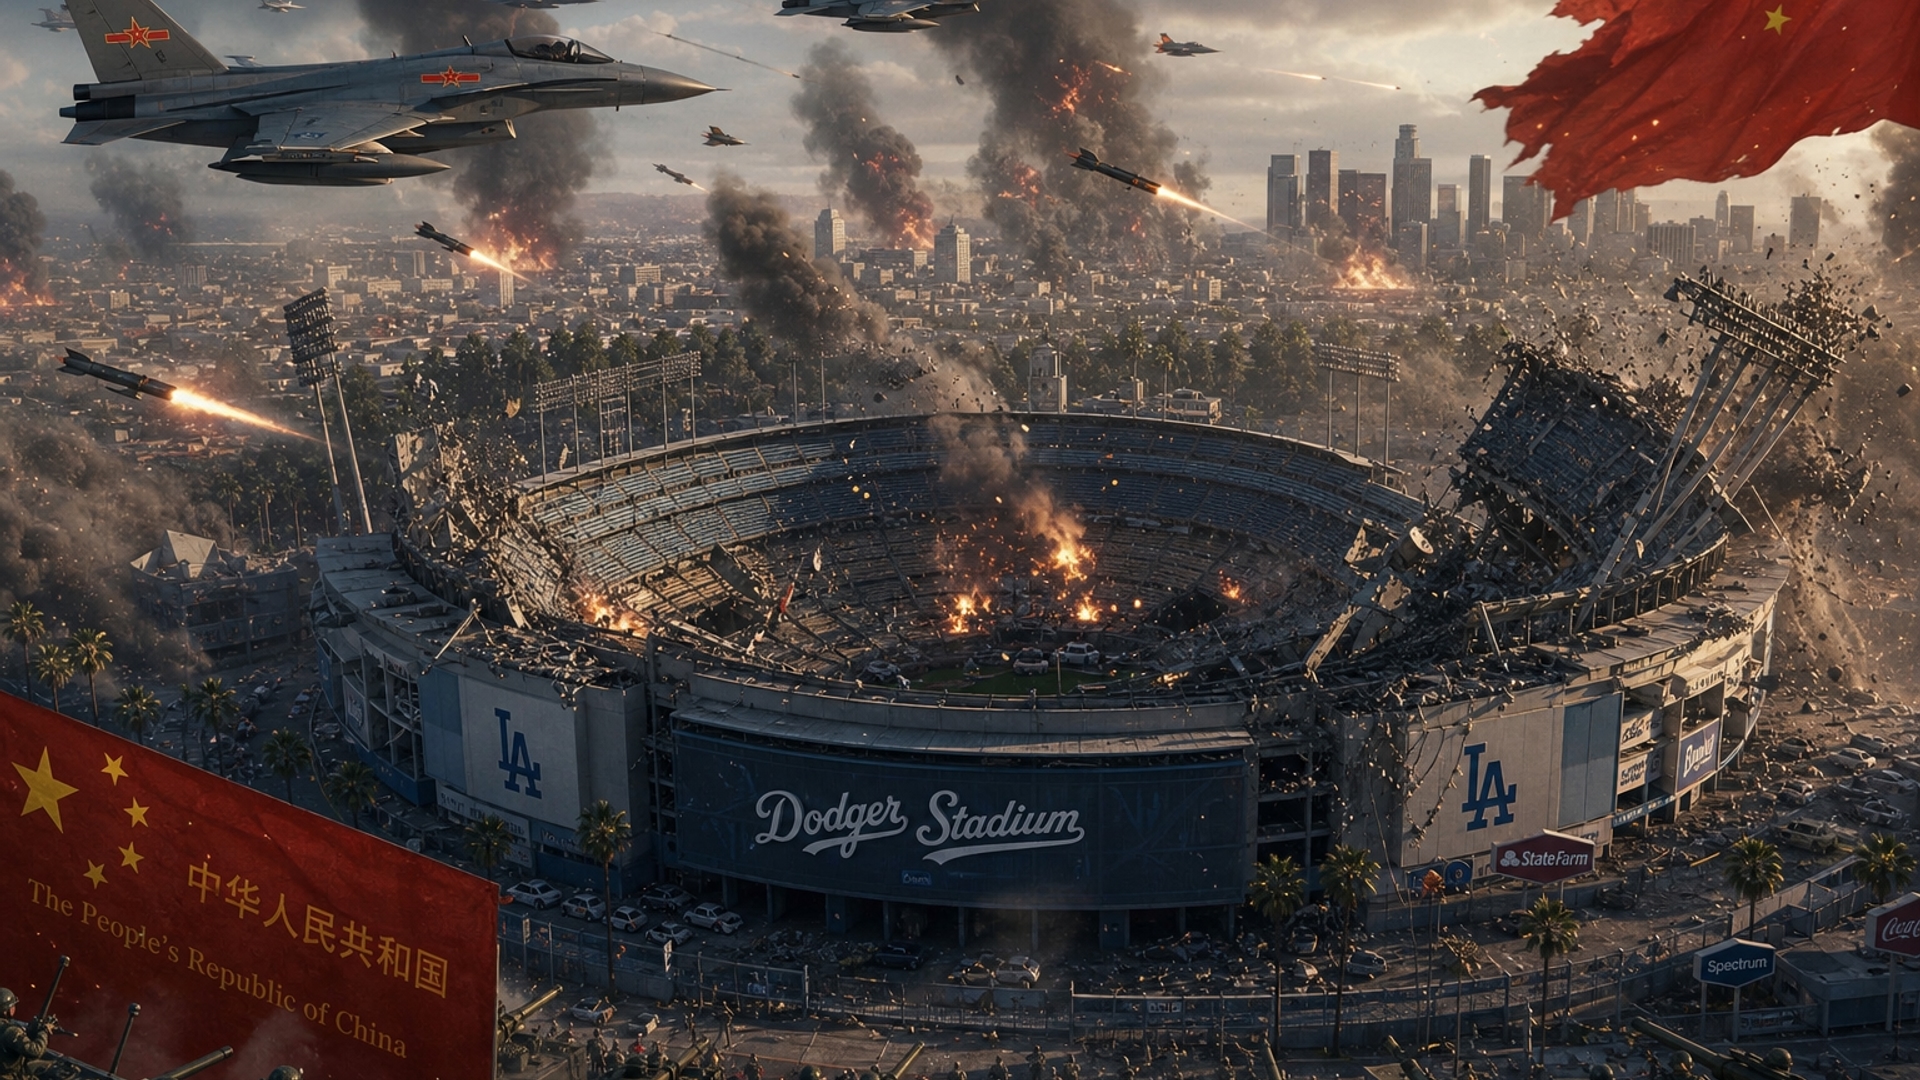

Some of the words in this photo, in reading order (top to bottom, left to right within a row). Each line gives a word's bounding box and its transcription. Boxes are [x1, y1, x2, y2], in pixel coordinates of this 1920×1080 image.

[494, 707, 542, 799] LA
[1462, 742, 1517, 831] LA
[755, 790, 909, 859] Dodger
[915, 790, 1085, 866] Stadium
[27, 878, 74, 917] The
[81, 901, 180, 964] People’s
[188, 947, 296, 1012] Republic
[303, 1002, 328, 1025] of
[336, 1011, 408, 1059] China
[187, 861, 449, 999] 中华人民共和国
[1707, 957, 1768, 975] Spectrum
